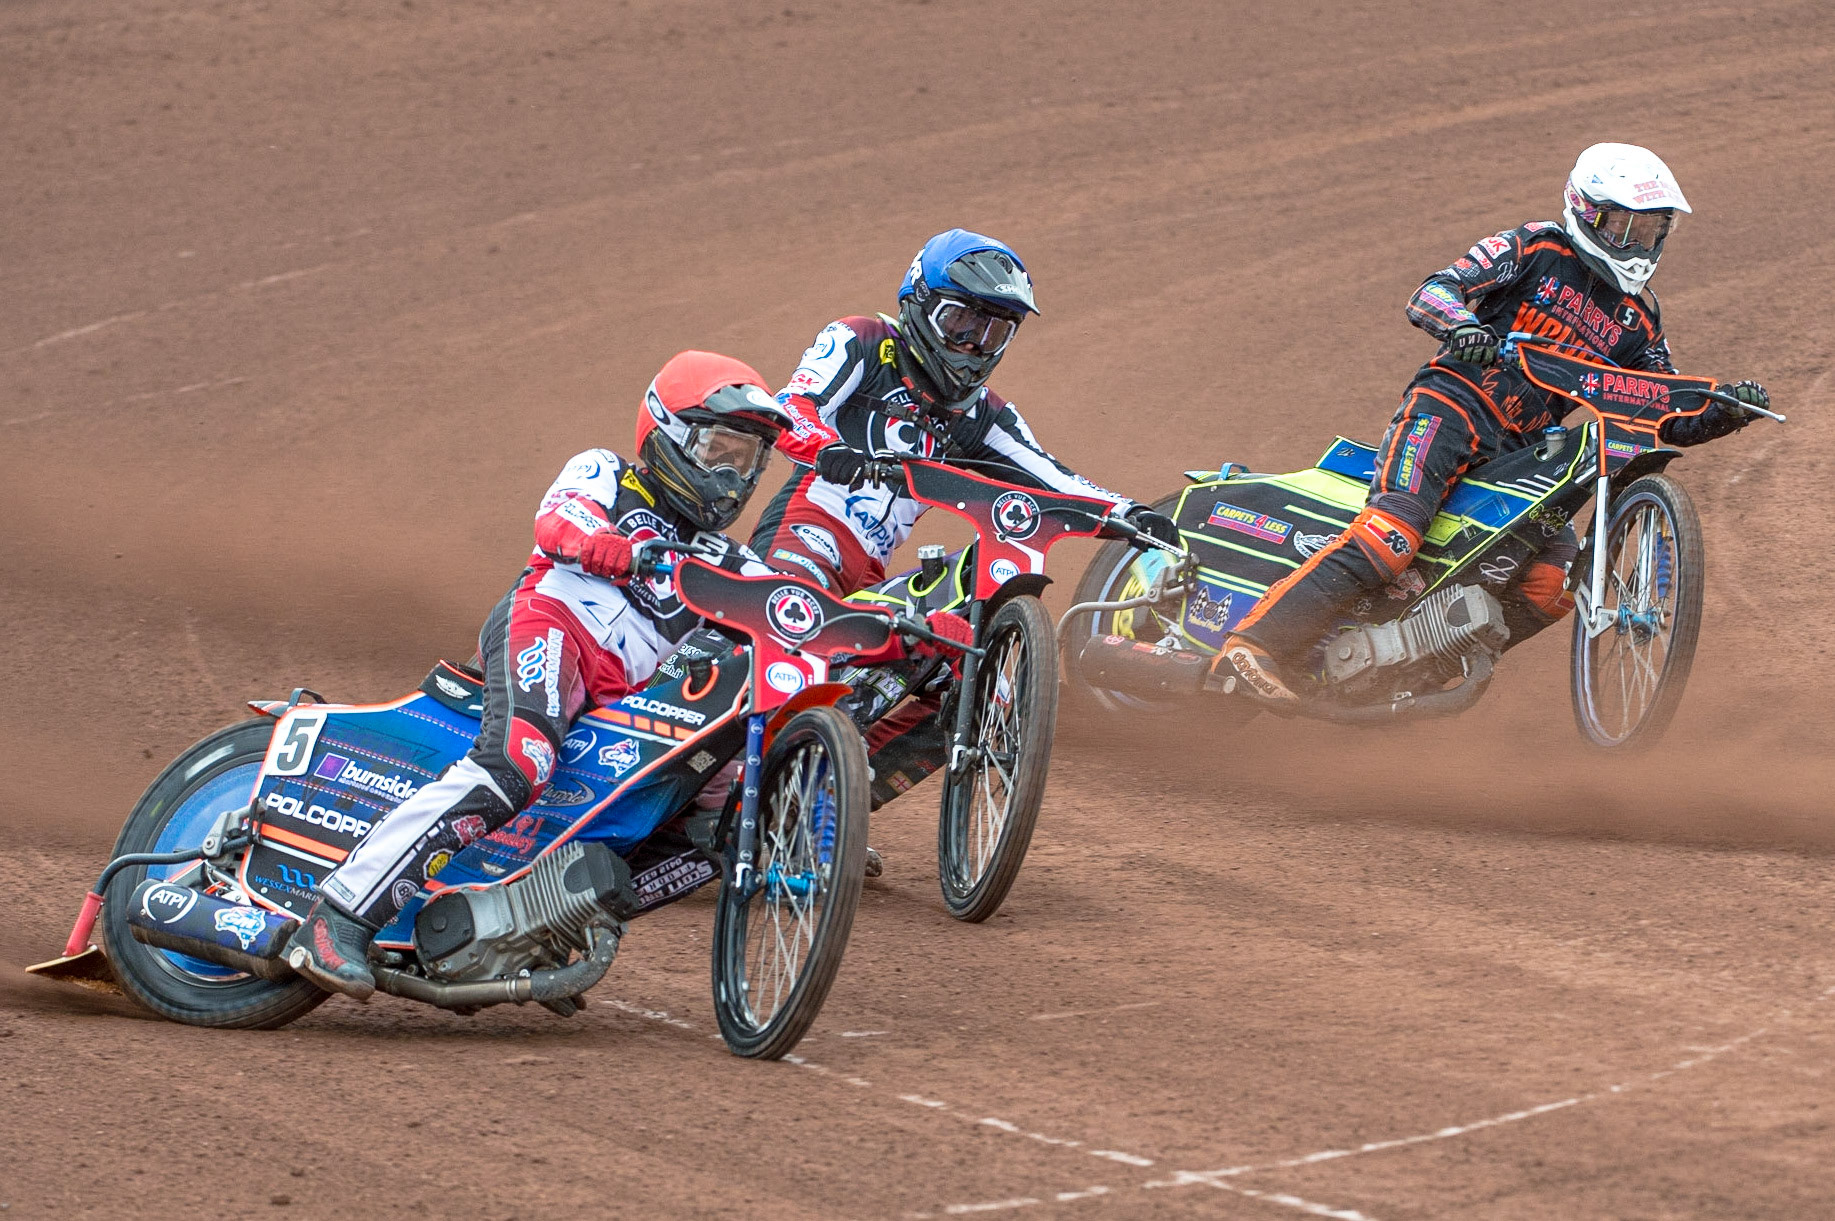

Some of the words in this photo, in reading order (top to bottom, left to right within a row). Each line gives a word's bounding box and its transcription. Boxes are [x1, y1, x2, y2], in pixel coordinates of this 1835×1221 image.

[1557, 284, 1623, 347] PARRYS
[1622, 307, 1635, 326] 5
[1603, 373, 1671, 404] PARRYS
[1407, 434, 1423, 447] 4
[1607, 442, 1633, 453] CARPETS
[1399, 445, 1417, 487] CARPETS
[995, 494, 1012, 509] BELLE
[1013, 493, 1026, 502] VUE
[627, 513, 658, 530] BELLE
[1216, 505, 1257, 524] CARPETS
[1254, 514, 1269, 530] 4
[1263, 520, 1288, 534] LESS
[770, 588, 789, 605] BELLE
[790, 589, 805, 599] VUE
[805, 598, 820, 615] ACES
[774, 671, 798, 684] ATPI
[620, 695, 706, 725] POLCOPPER
[276, 718, 319, 772] 5
[562, 738, 589, 751] ATPI
[265, 792, 373, 838] POLCOPP
[150, 888, 188, 909] ATPI
[254, 874, 324, 903] WESSEXMARIN
